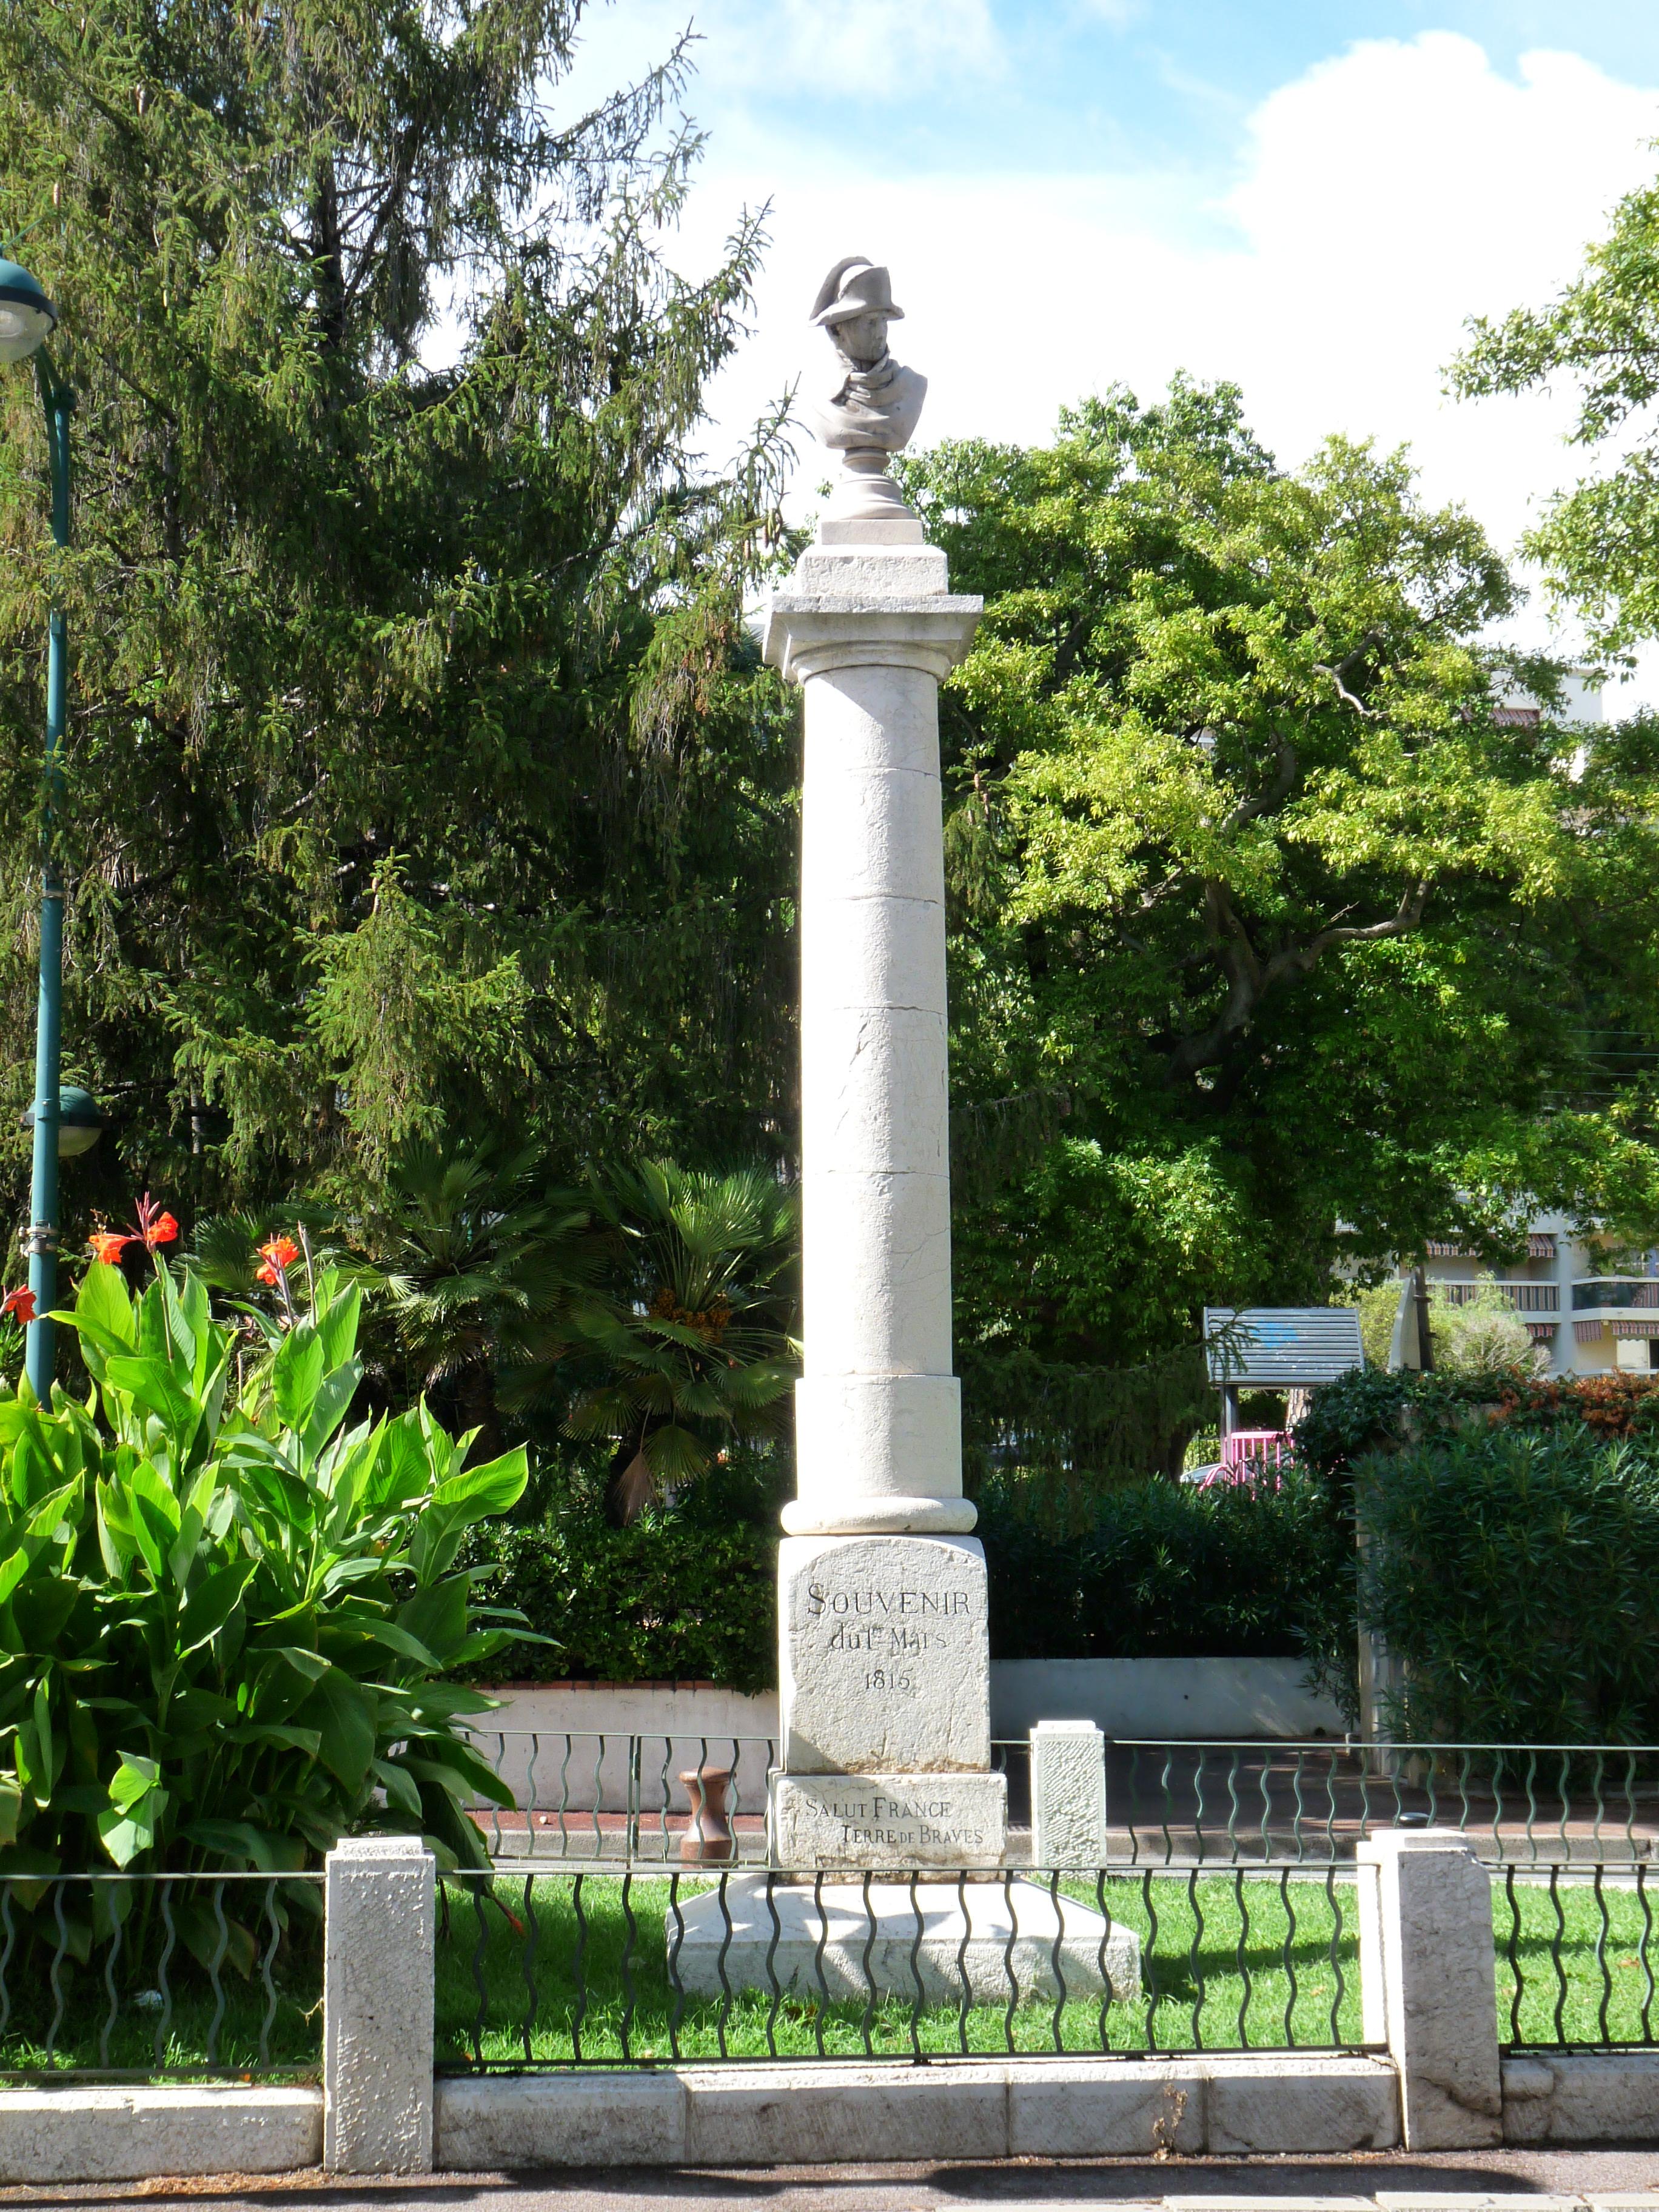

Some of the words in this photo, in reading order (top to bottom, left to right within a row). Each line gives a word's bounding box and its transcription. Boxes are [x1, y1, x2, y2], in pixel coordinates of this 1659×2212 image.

[808, 1583, 970, 1615] SOUVENIR
[831, 1623, 860, 1649] du
[891, 1627, 947, 1649] Mars
[866, 1668, 913, 1689] 1815
[806, 1798, 867, 1818] SALUT
[873, 1797, 951, 1818] FRANCE
[841, 1825, 896, 1843] TERRE
[900, 1831, 914, 1843] DE
[919, 1825, 984, 1844] BRAVES
